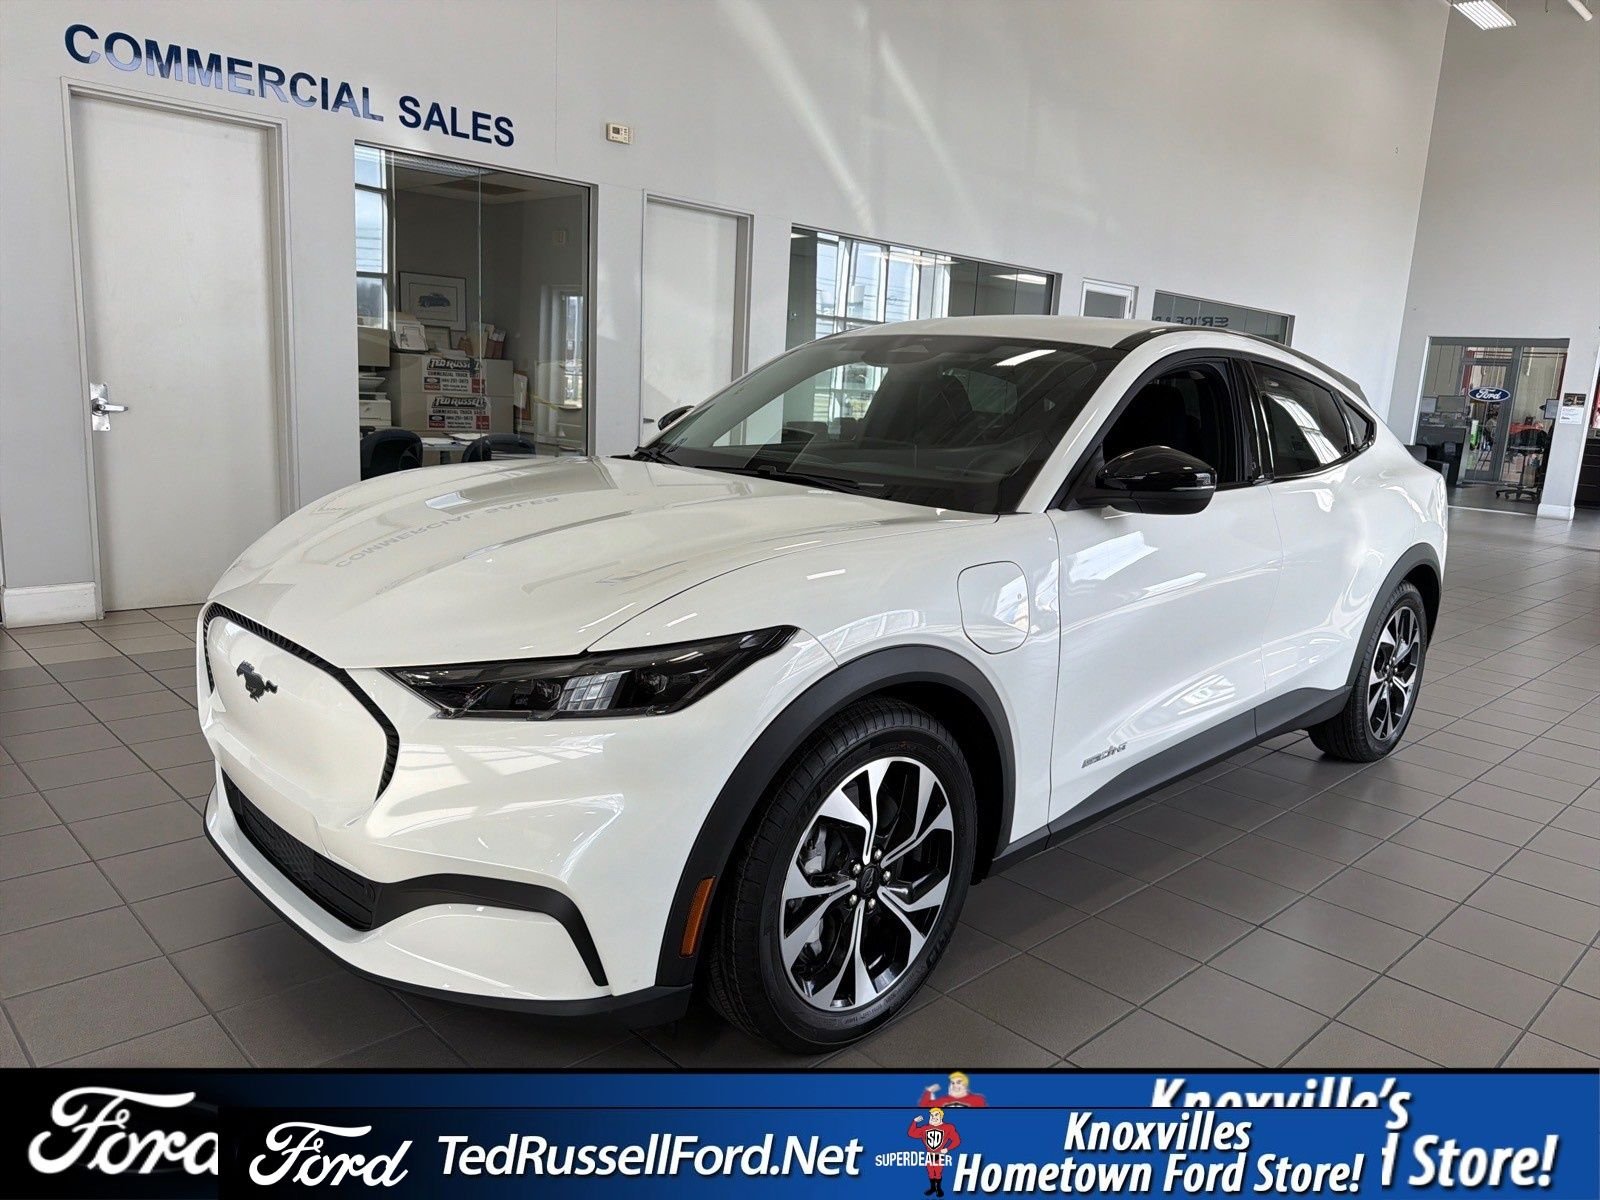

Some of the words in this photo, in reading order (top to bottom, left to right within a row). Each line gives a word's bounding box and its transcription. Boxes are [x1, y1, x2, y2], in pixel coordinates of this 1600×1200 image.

[64, 24, 384, 122] COMMERCIAL
[398, 95, 515, 148] SALES
[1475, 388, 1501, 400] Ford
